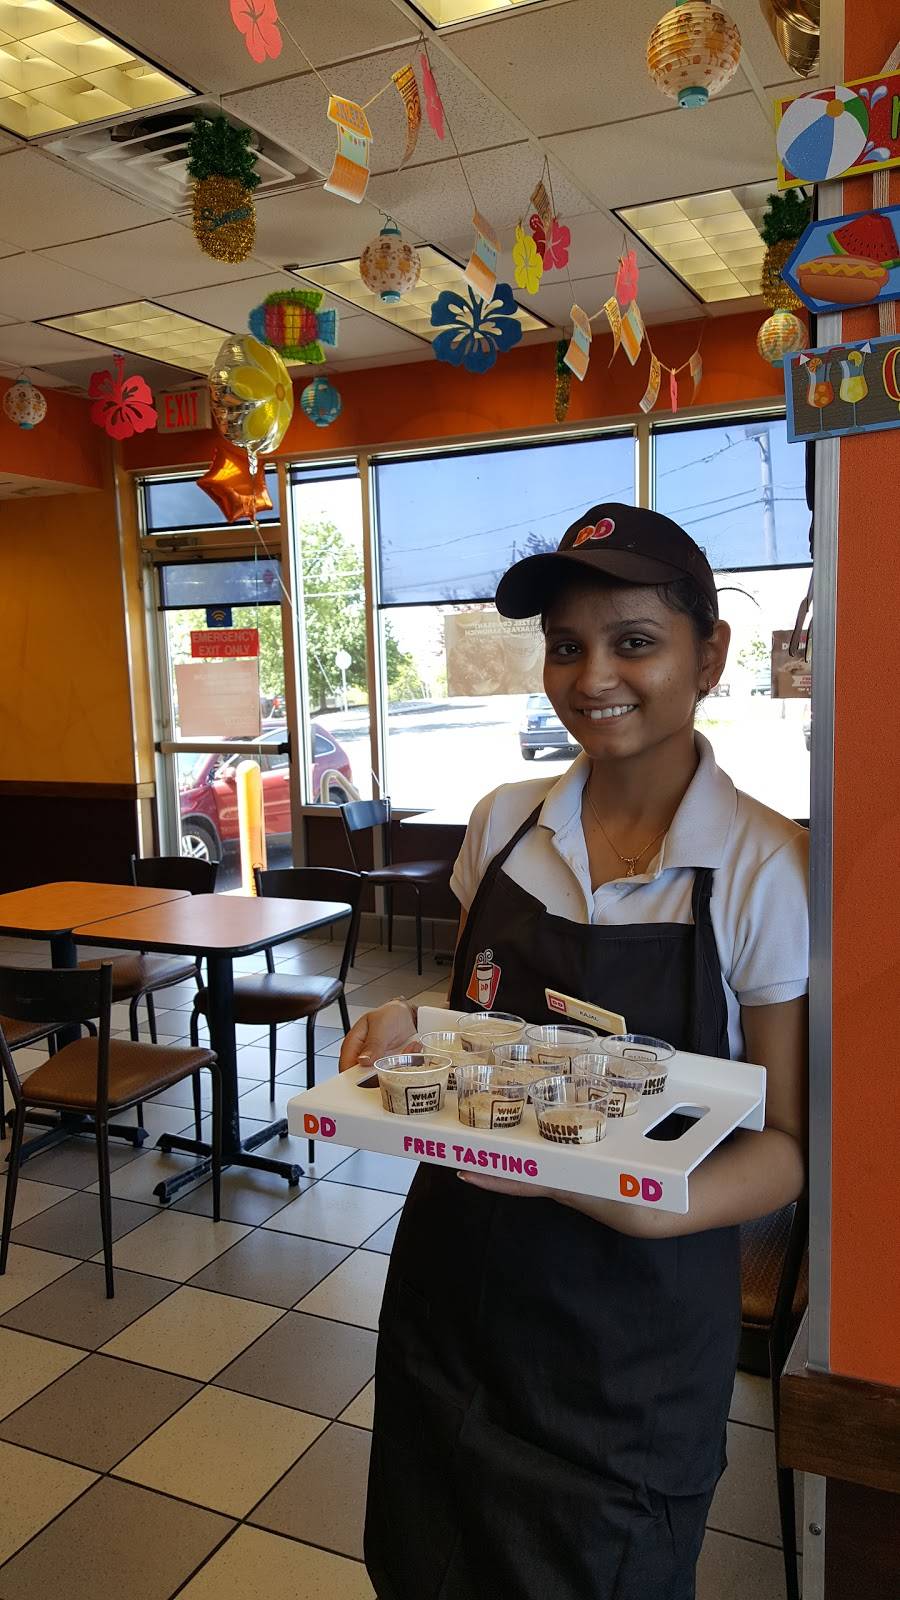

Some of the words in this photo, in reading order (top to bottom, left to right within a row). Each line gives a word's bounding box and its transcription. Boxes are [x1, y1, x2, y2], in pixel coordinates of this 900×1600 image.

[164, 391, 198, 428] EXIT
[572, 517, 615, 547] DD
[192, 632, 257, 643] EMERGENCY
[200, 645, 220, 656] EXIT
[224, 644, 251, 655] ONLY
[580, 1010, 600, 1021] KAJAL
[411, 1091, 437, 1101] WHAT
[497, 1106, 521, 1115] WHAT
[303, 1113, 337, 1138] DD
[403, 1136, 446, 1159] FREE
[452, 1145, 539, 1177] TASTING
[619, 1173, 663, 1202] DD
